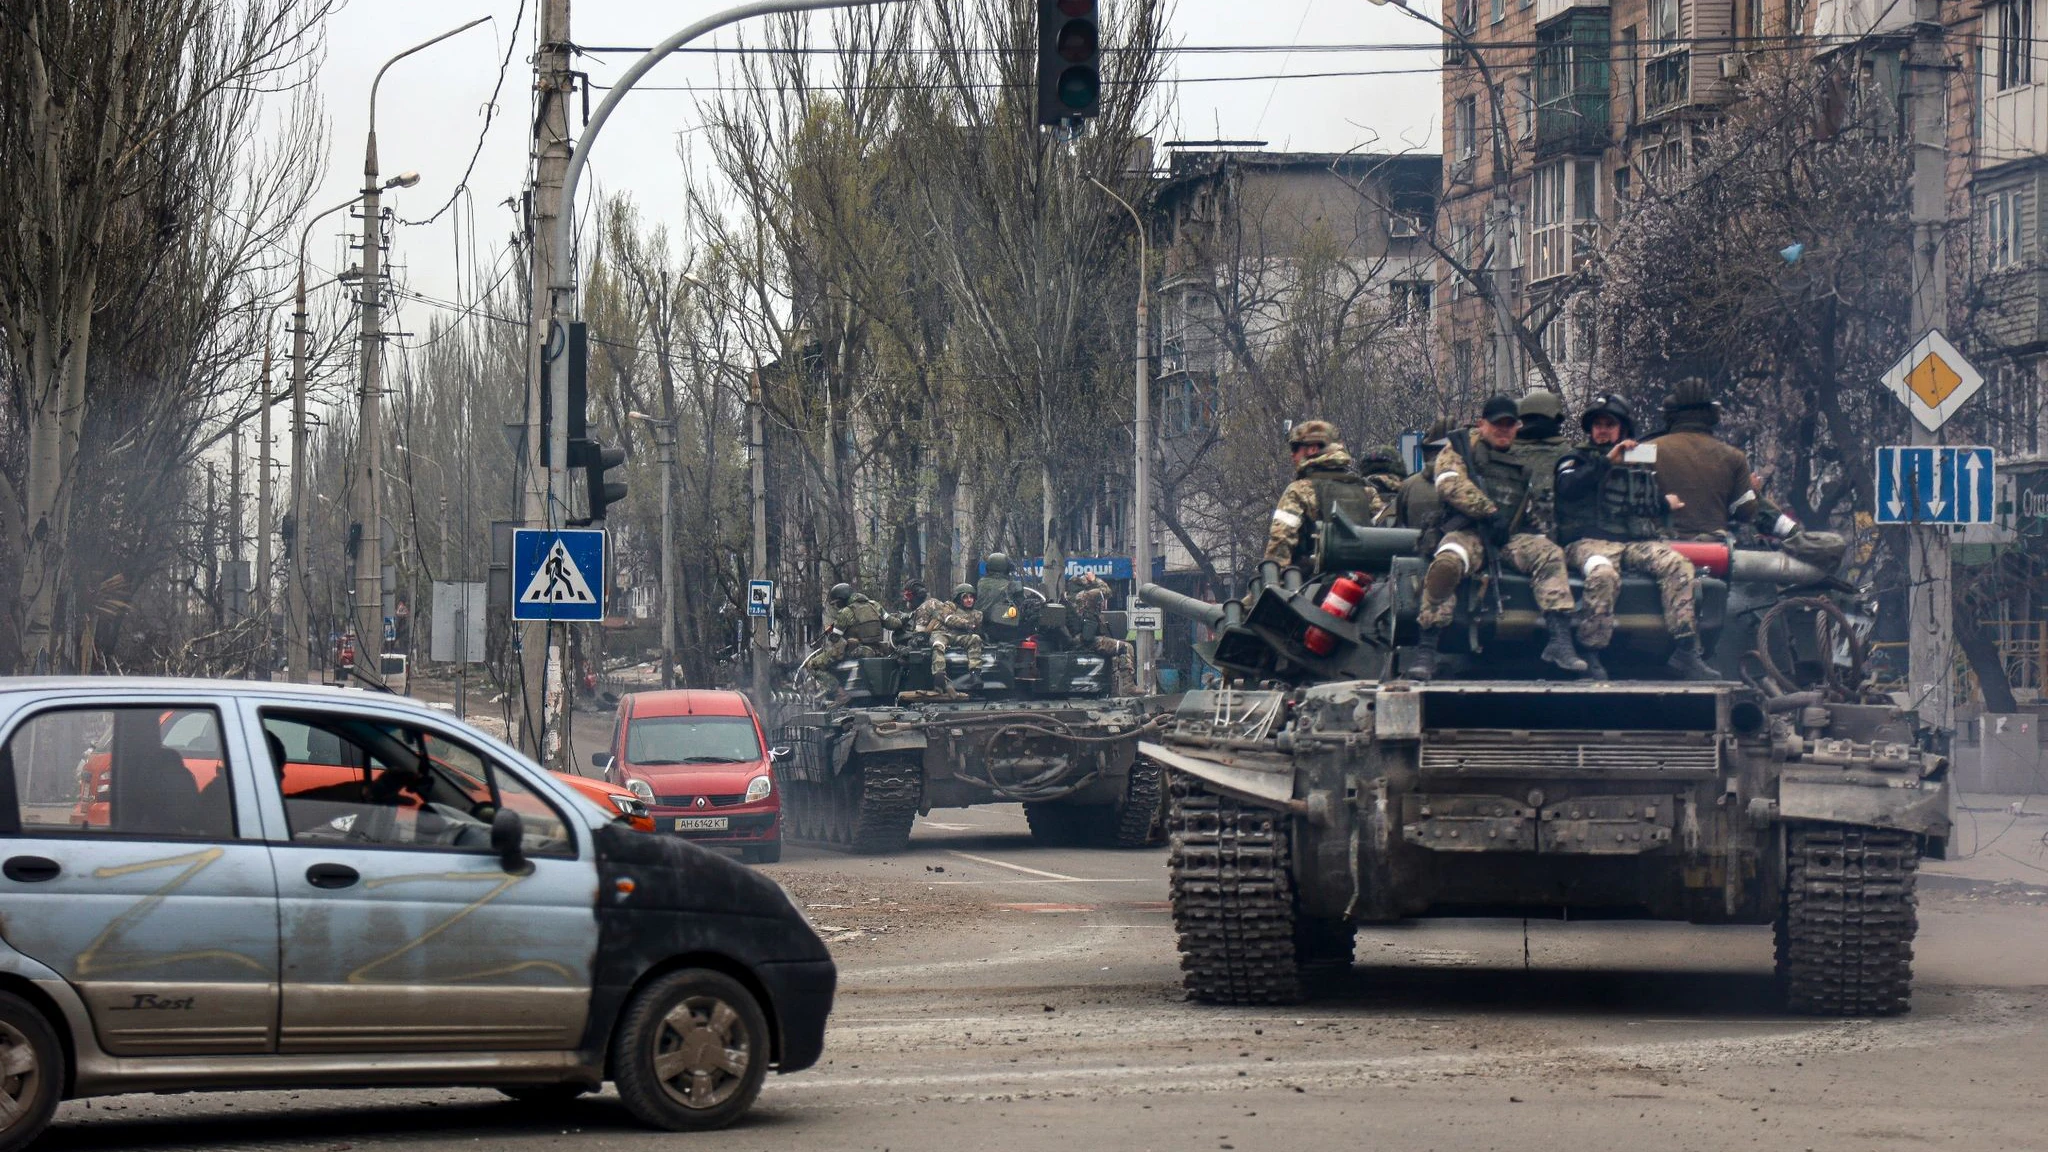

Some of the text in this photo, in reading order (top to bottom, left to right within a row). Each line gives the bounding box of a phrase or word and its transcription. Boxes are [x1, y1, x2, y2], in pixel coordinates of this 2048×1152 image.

[1070, 657, 1105, 692] Z
[76, 847, 272, 976] Z
[348, 871, 576, 985] Z
[112, 993, 194, 1010] Best
